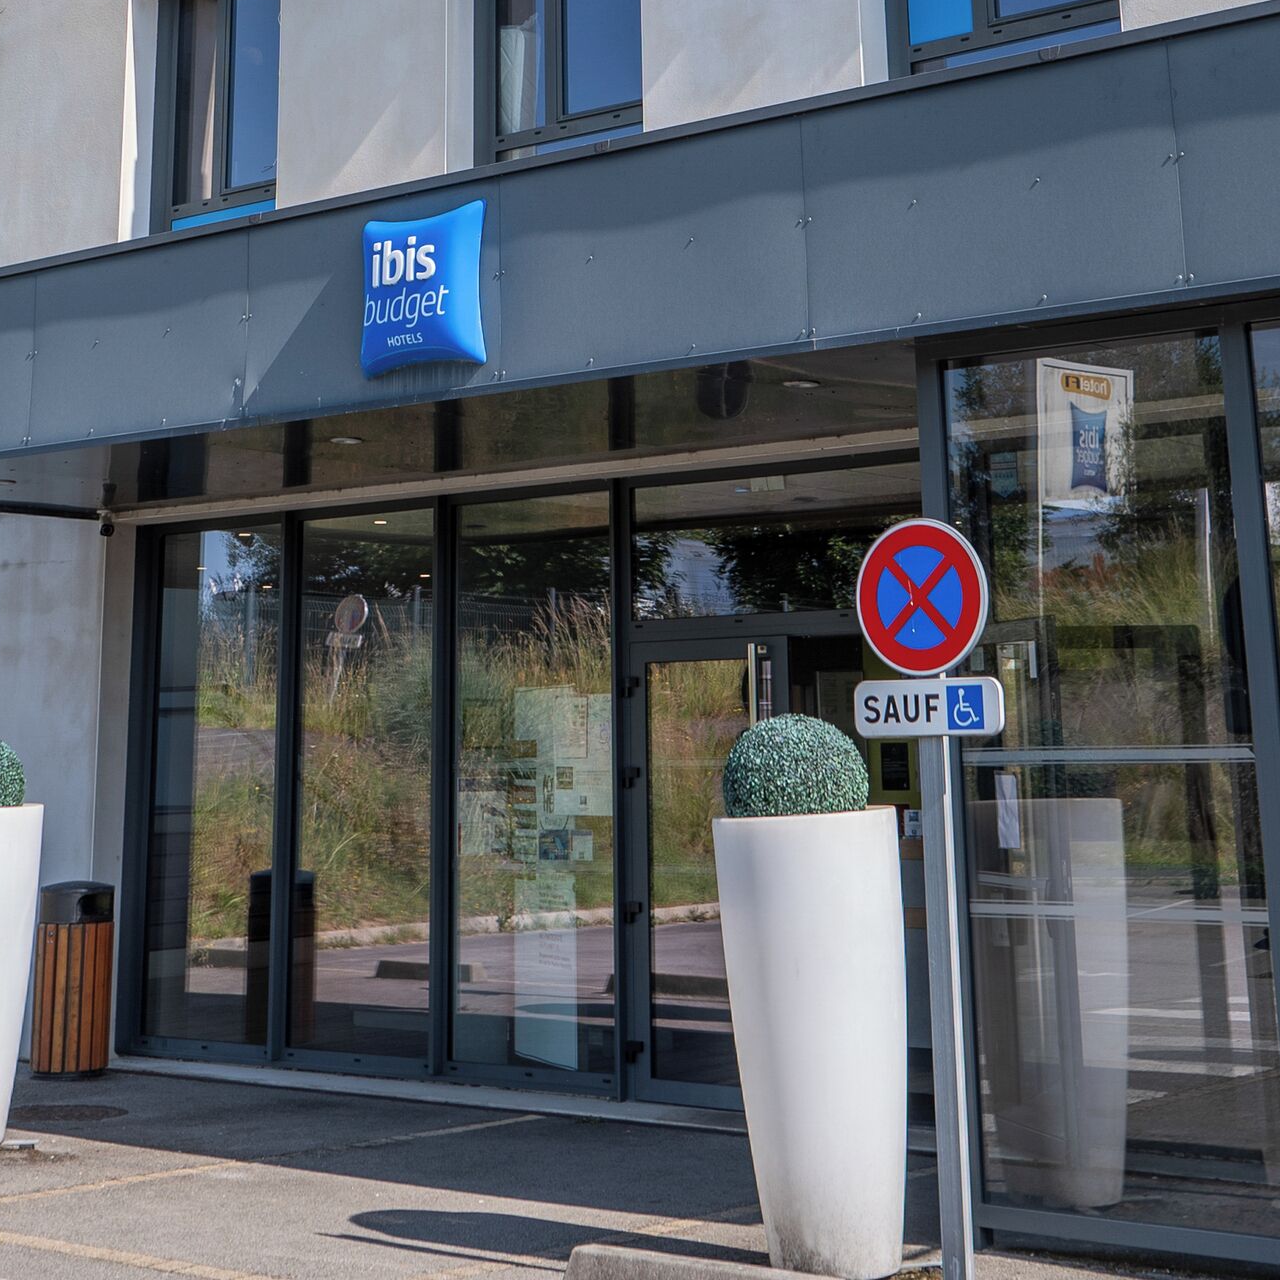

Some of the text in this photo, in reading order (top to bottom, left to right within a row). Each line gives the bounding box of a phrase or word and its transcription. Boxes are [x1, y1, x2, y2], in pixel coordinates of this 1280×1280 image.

[371, 235, 436, 288] ibis
[364, 285, 450, 328] budget
[387, 332, 424, 348] HOTELS
[863, 693, 939, 724] SAUF
